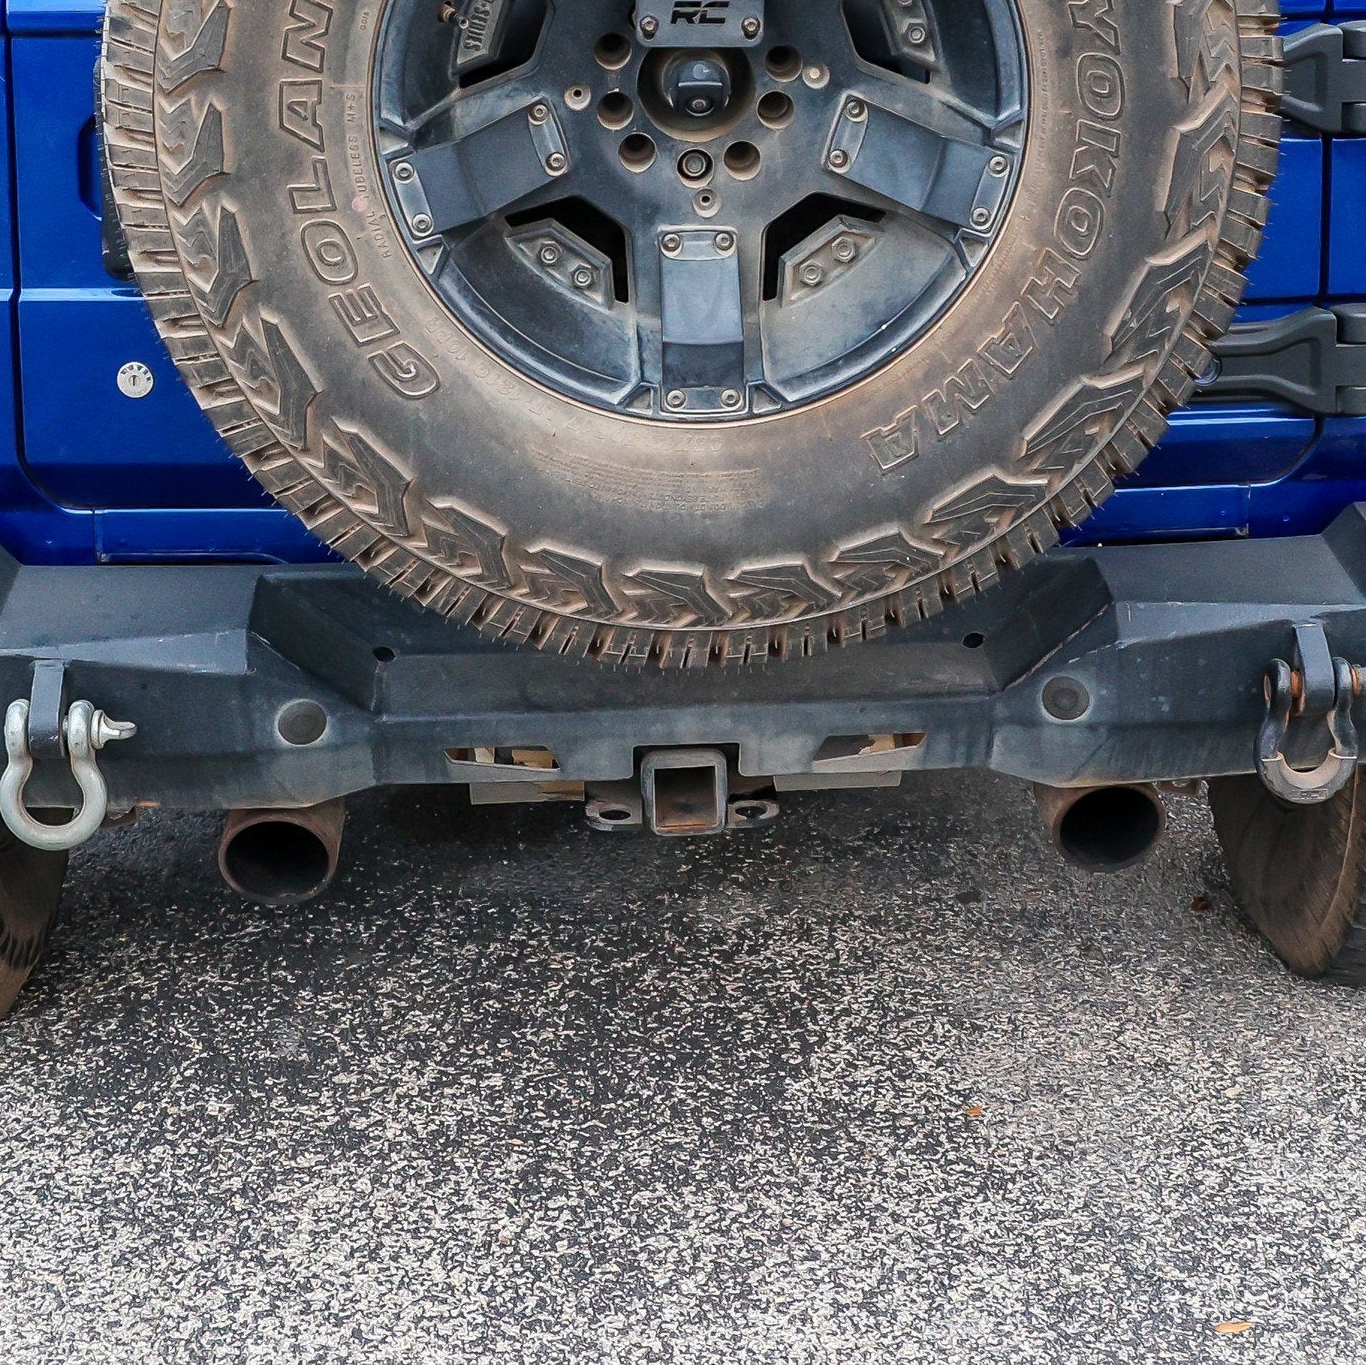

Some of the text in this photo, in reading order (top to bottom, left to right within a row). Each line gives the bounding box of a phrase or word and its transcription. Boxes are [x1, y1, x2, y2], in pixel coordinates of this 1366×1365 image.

[669, 0, 732, 25] RC
[346, 93, 357, 123] M+S
[366, 210, 393, 259] RADIAL
